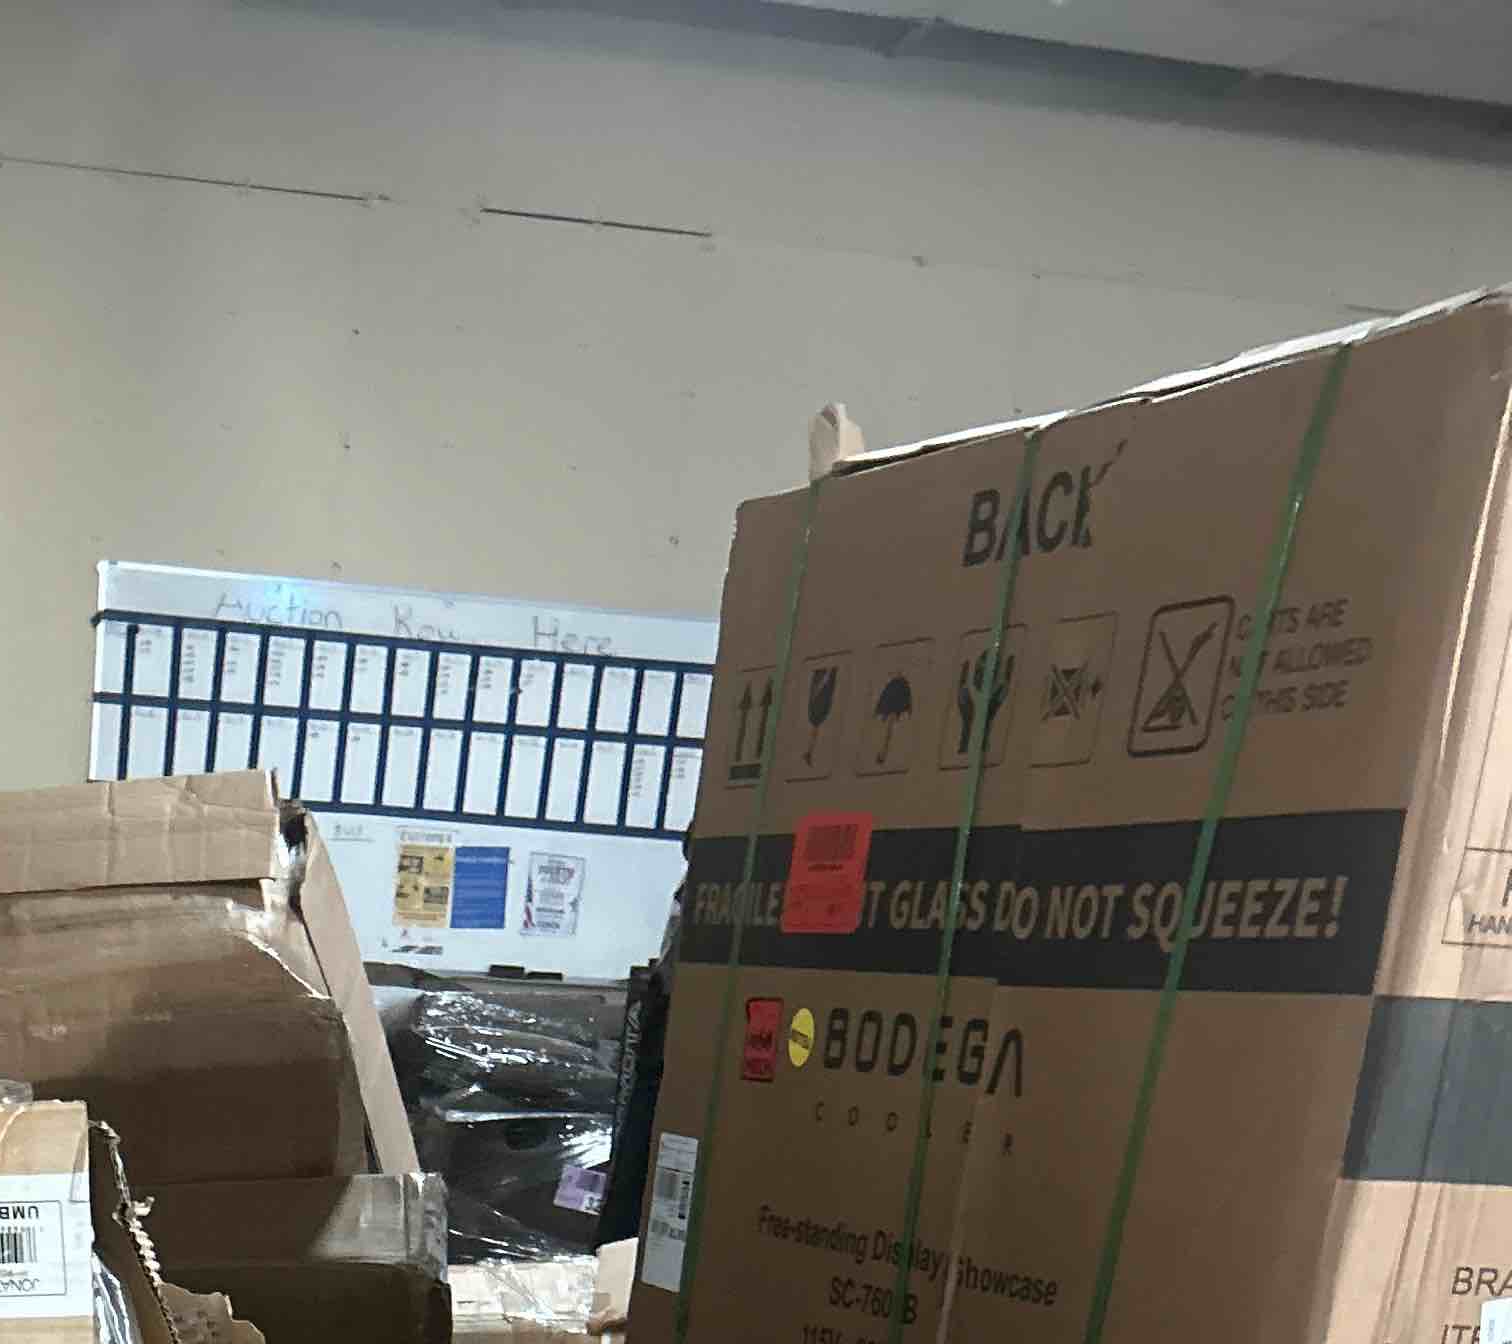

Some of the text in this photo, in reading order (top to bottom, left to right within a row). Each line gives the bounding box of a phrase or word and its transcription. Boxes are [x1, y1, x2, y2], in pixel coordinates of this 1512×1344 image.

[961, 460, 1103, 567] BACK
[215, 593, 344, 630] Auction
[531, 615, 615, 656] Here
[991, 881, 1039, 941] DO
[1043, 883, 1126, 940] NOT
[1125, 876, 1349, 954] SQUEEZE!
[757, 1204, 869, 1265] Free-standing
[871, 1228, 943, 1281] Dislay
